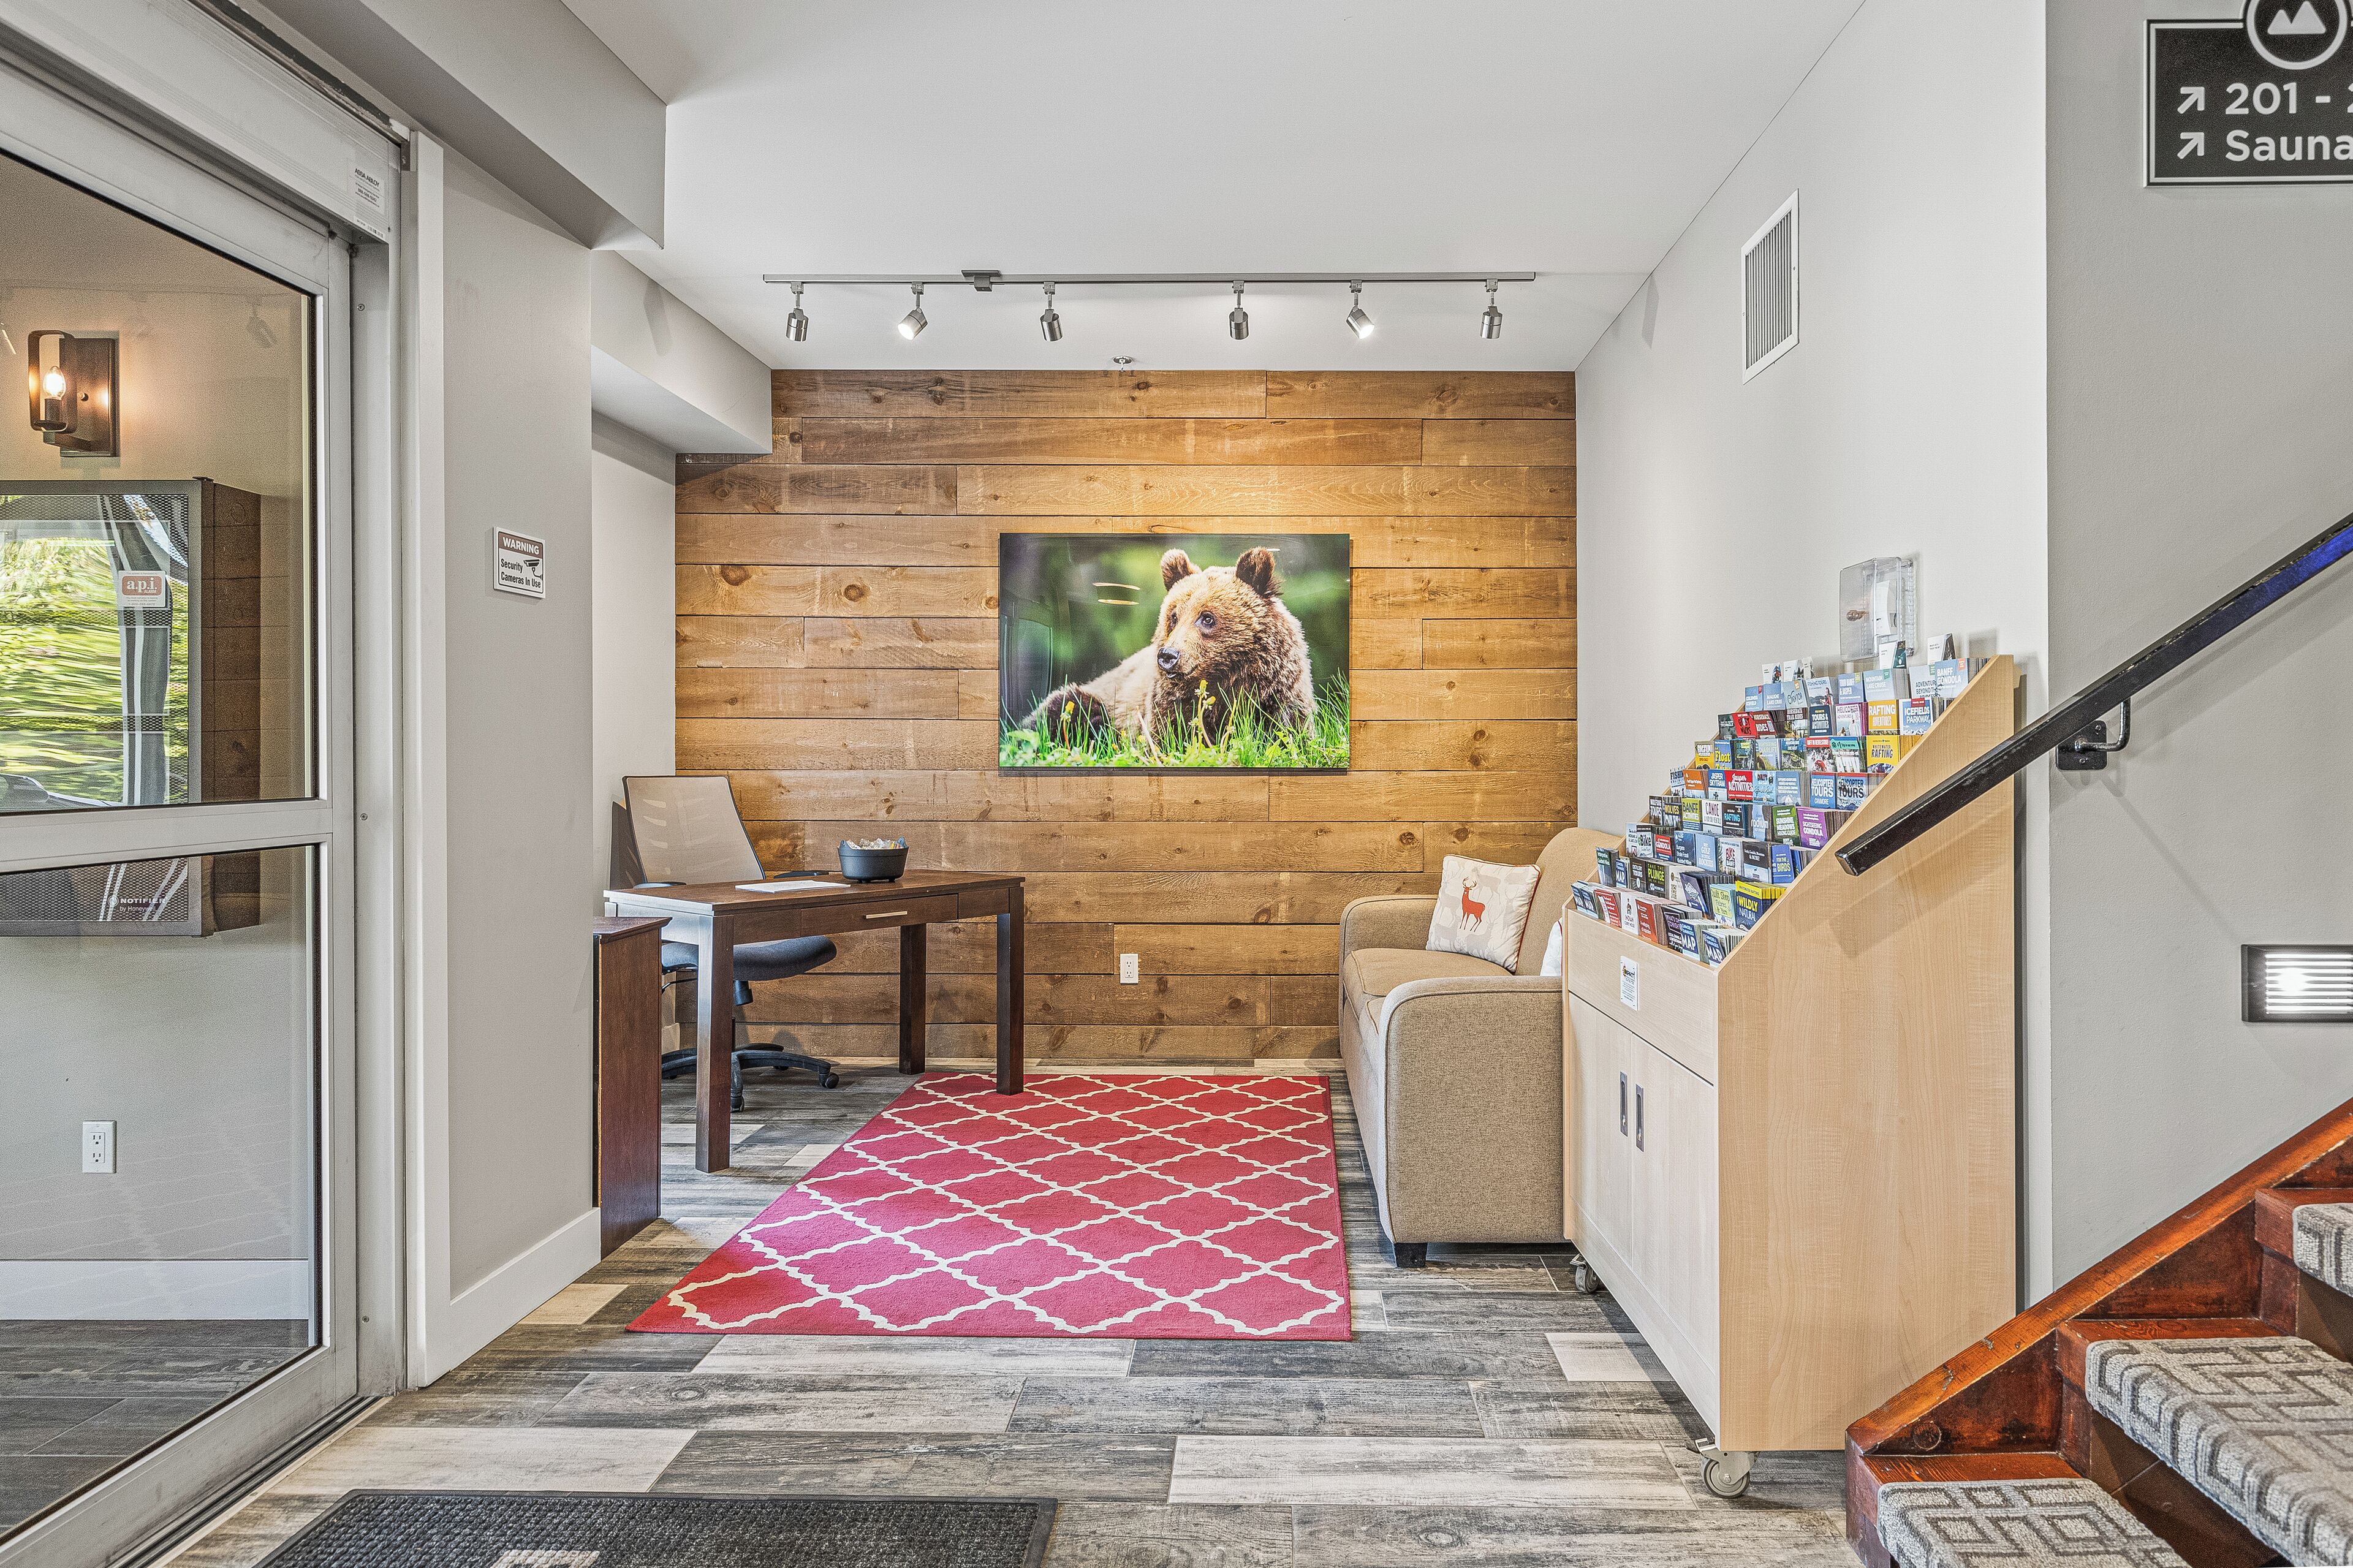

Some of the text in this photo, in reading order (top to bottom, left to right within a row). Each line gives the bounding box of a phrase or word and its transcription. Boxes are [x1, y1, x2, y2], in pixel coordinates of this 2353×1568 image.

[2225, 82, 2297, 115] 201
[2225, 129, 2353, 162] Sauna
[502, 537, 539, 555] WARNING
[501, 558, 523, 574] Security
[501, 571, 541, 588] Cameras In Use
[127, 577, 157, 594] a.p.i.
[1937, 667, 1953, 676] BANFF
[1937, 675, 1961, 684] GONDOLA
[1869, 705, 1895, 715] RAFTING
[1904, 706, 1930, 716] ICEFIELDS
[1812, 721, 1829, 729] ACTIVITIES
[1715, 751, 1730, 763] Float
[1871, 749, 1893, 758] RAFTING
[1670, 771, 1683, 780] FISHIN
[1732, 773, 1746, 782] Jasper
[1729, 782, 1753, 792] ACTIVITIES
[1838, 779, 1863, 787] HELICOPTER
[1811, 787, 1833, 797] TOURS
[1839, 787, 1864, 798] TOURS
[1650, 806, 1662, 816] TOURS
[1665, 805, 1680, 814] WOLVES
[1683, 802, 1698, 813] BANFF
[1705, 803, 1719, 817] CANOE
[1724, 813, 1740, 822] RAFTING
[1751, 817, 1768, 828] radium
[1803, 827, 1824, 836] GONDOLA
[1638, 835, 1651, 847] eBike
[1777, 863, 1790, 872] BIRDS
[1616, 871, 1625, 882] MAP
[1648, 868, 1664, 881] PLUNGE
[1739, 896, 1758, 912] WILDLY
[1739, 907, 1756, 922] NATURAL
[1681, 933, 1696, 950] MAP
[1705, 944, 1722, 962] MAP
